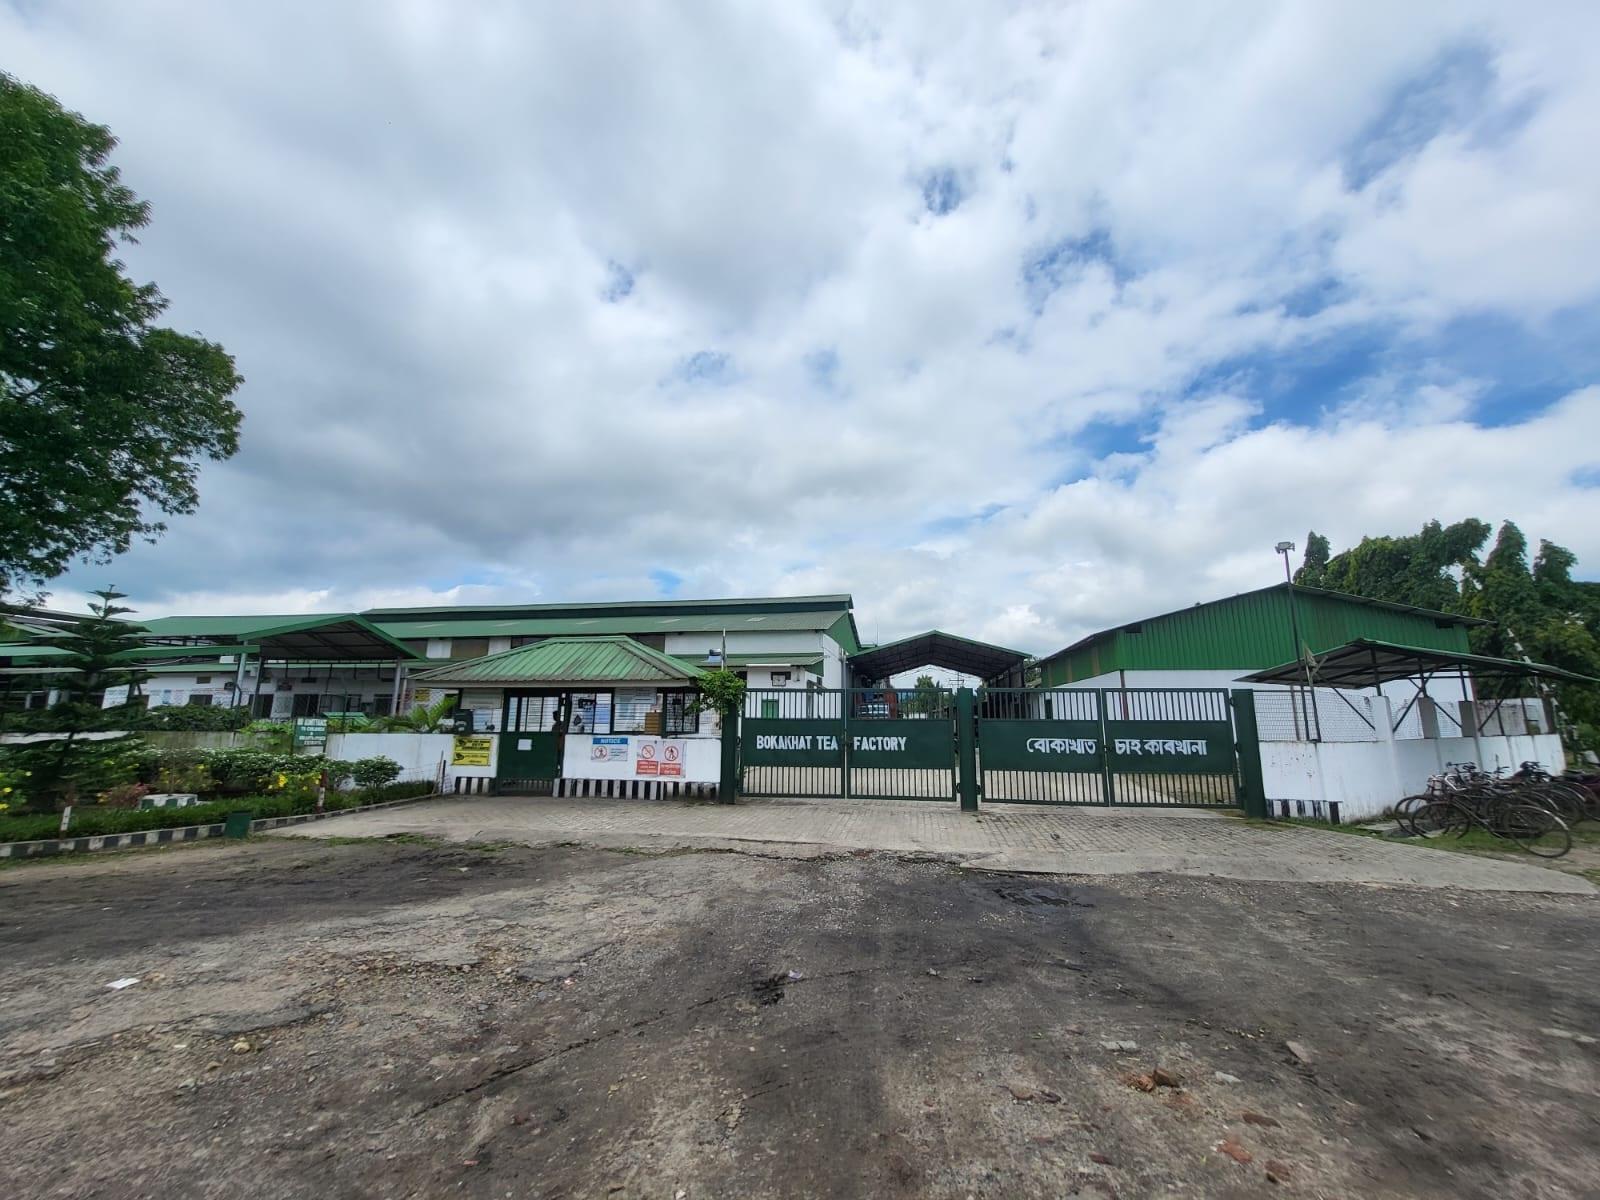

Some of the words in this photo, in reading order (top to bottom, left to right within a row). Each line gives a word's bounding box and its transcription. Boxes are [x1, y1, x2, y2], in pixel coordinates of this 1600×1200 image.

[756, 735, 812, 750] BOKAKHAT
[816, 735, 839, 750] TEA
[853, 736, 907, 751] FACTORY
[1026, 737, 1098, 755] বোকাখাত
[1114, 738, 1142, 755] চাহ
